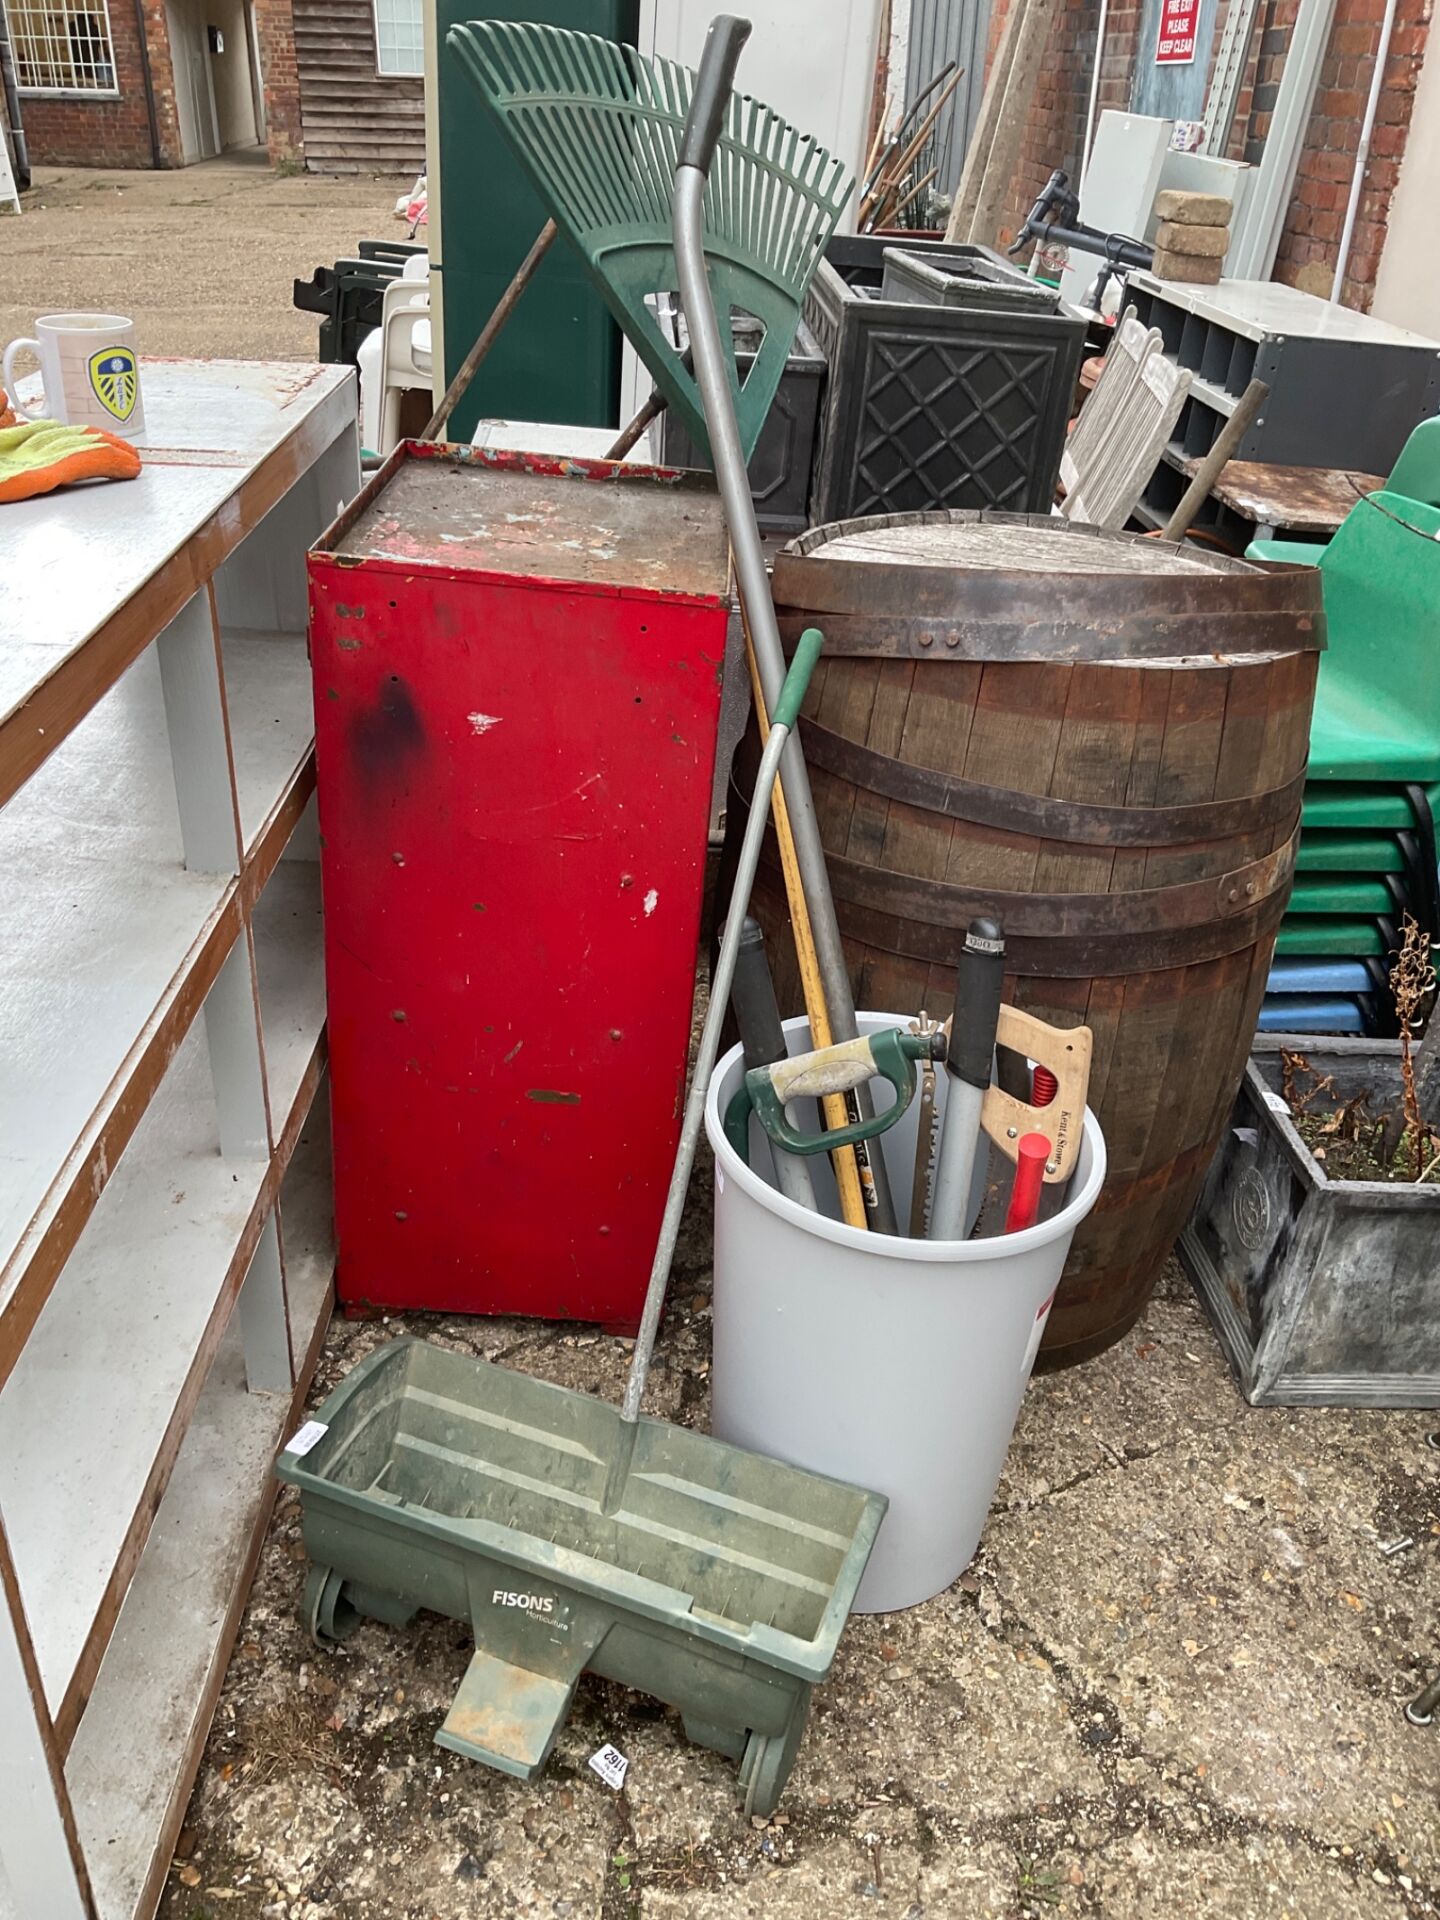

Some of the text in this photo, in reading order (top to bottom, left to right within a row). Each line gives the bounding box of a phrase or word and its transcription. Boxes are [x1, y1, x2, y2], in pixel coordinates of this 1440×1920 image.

[1167, 0, 1194, 14] FIRE EXIT
[1167, 18, 1190, 34] PLEASE
[1159, 38, 1193, 54] KEEP CLEAR
[1059, 1110, 1072, 1132] Kent
[1054, 1138, 1068, 1165] Stowe
[492, 1590, 554, 1612] FISONS
[525, 1609, 569, 1631] Horticulture
[604, 1749, 626, 1772] 1162
